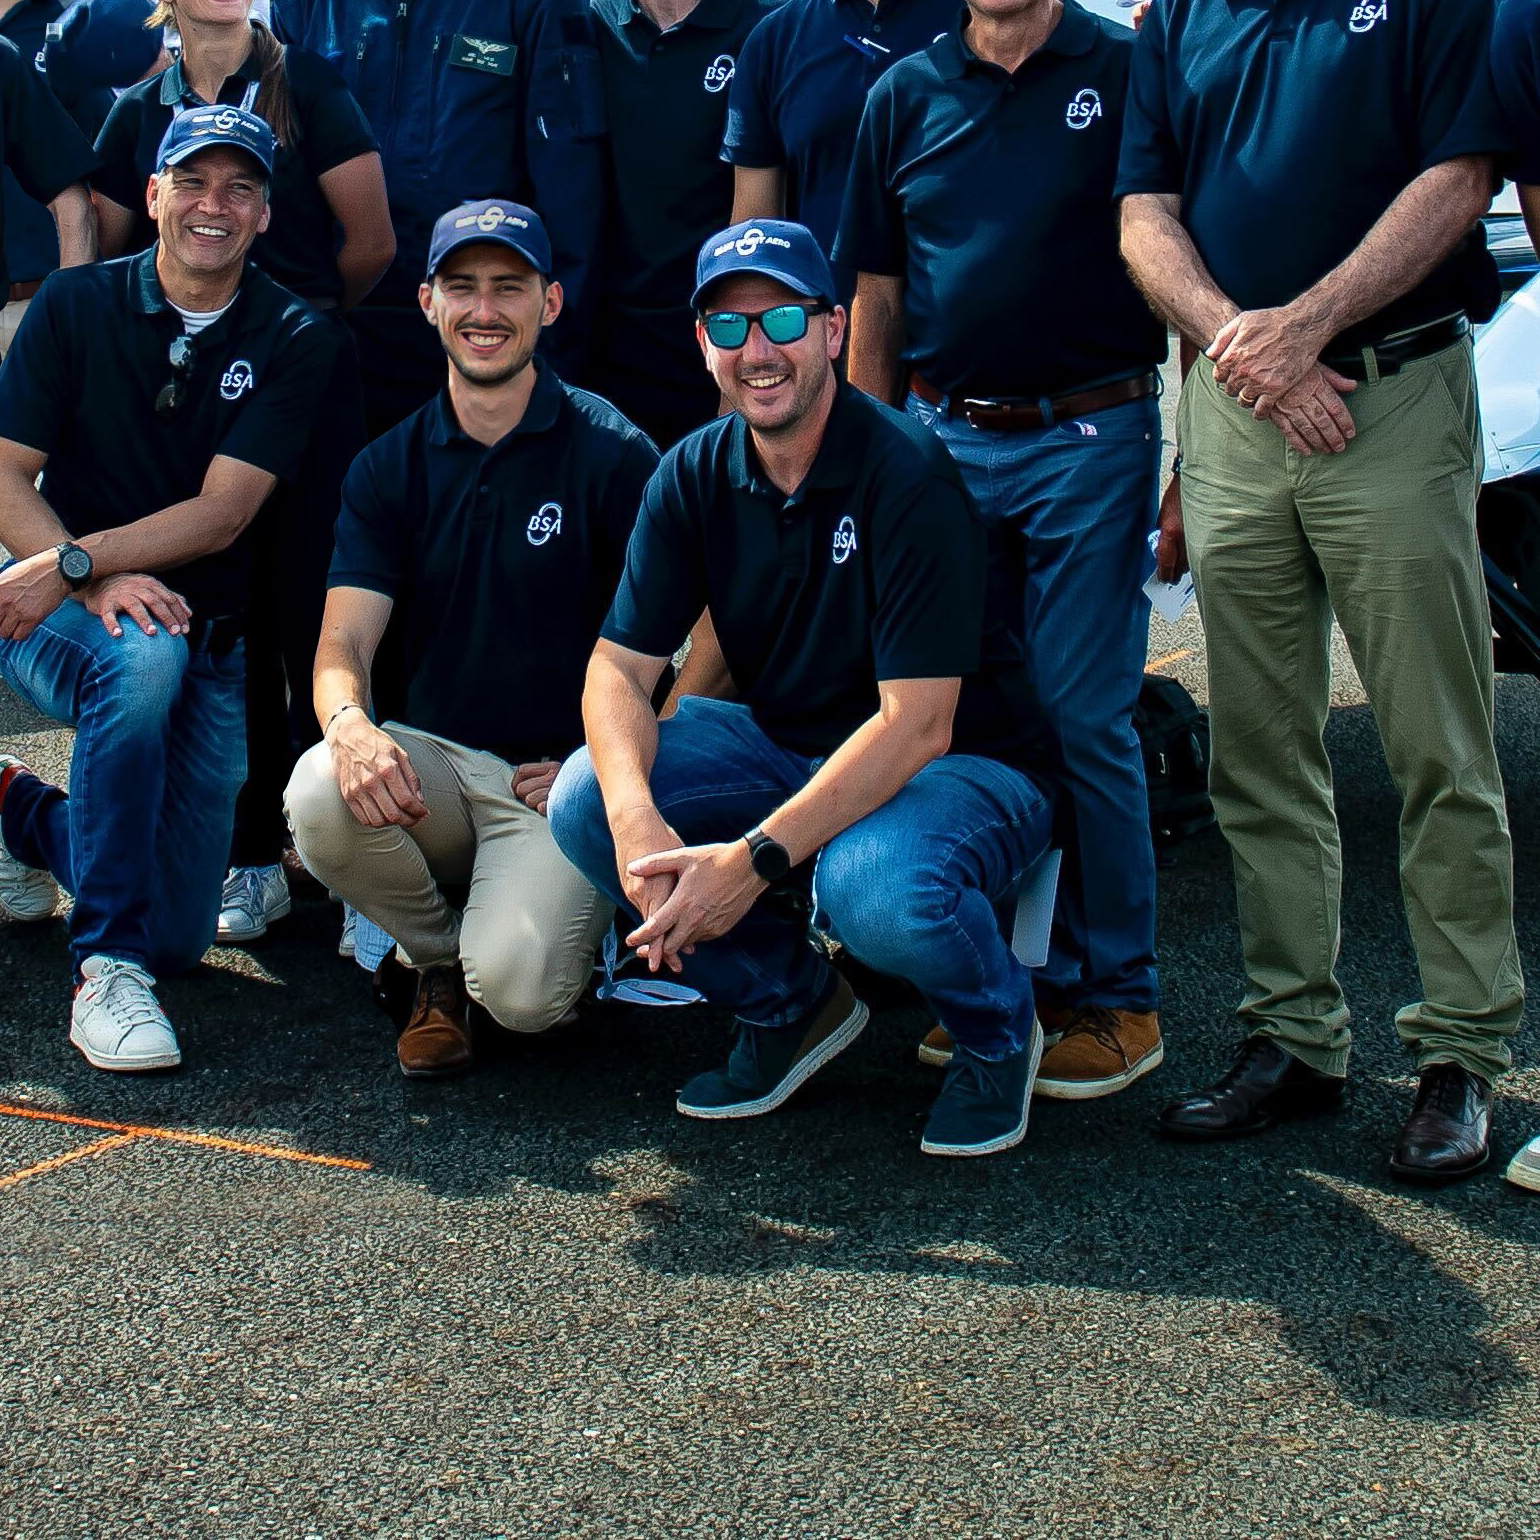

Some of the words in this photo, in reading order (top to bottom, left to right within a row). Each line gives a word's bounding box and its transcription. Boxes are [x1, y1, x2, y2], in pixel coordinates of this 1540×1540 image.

[1349, 3, 1388, 21] BSA
[1066, 101, 1103, 117] BSA
[220, 372, 253, 389] BSA
[527, 515, 562, 535] BSA
[832, 531, 857, 550] BSA
